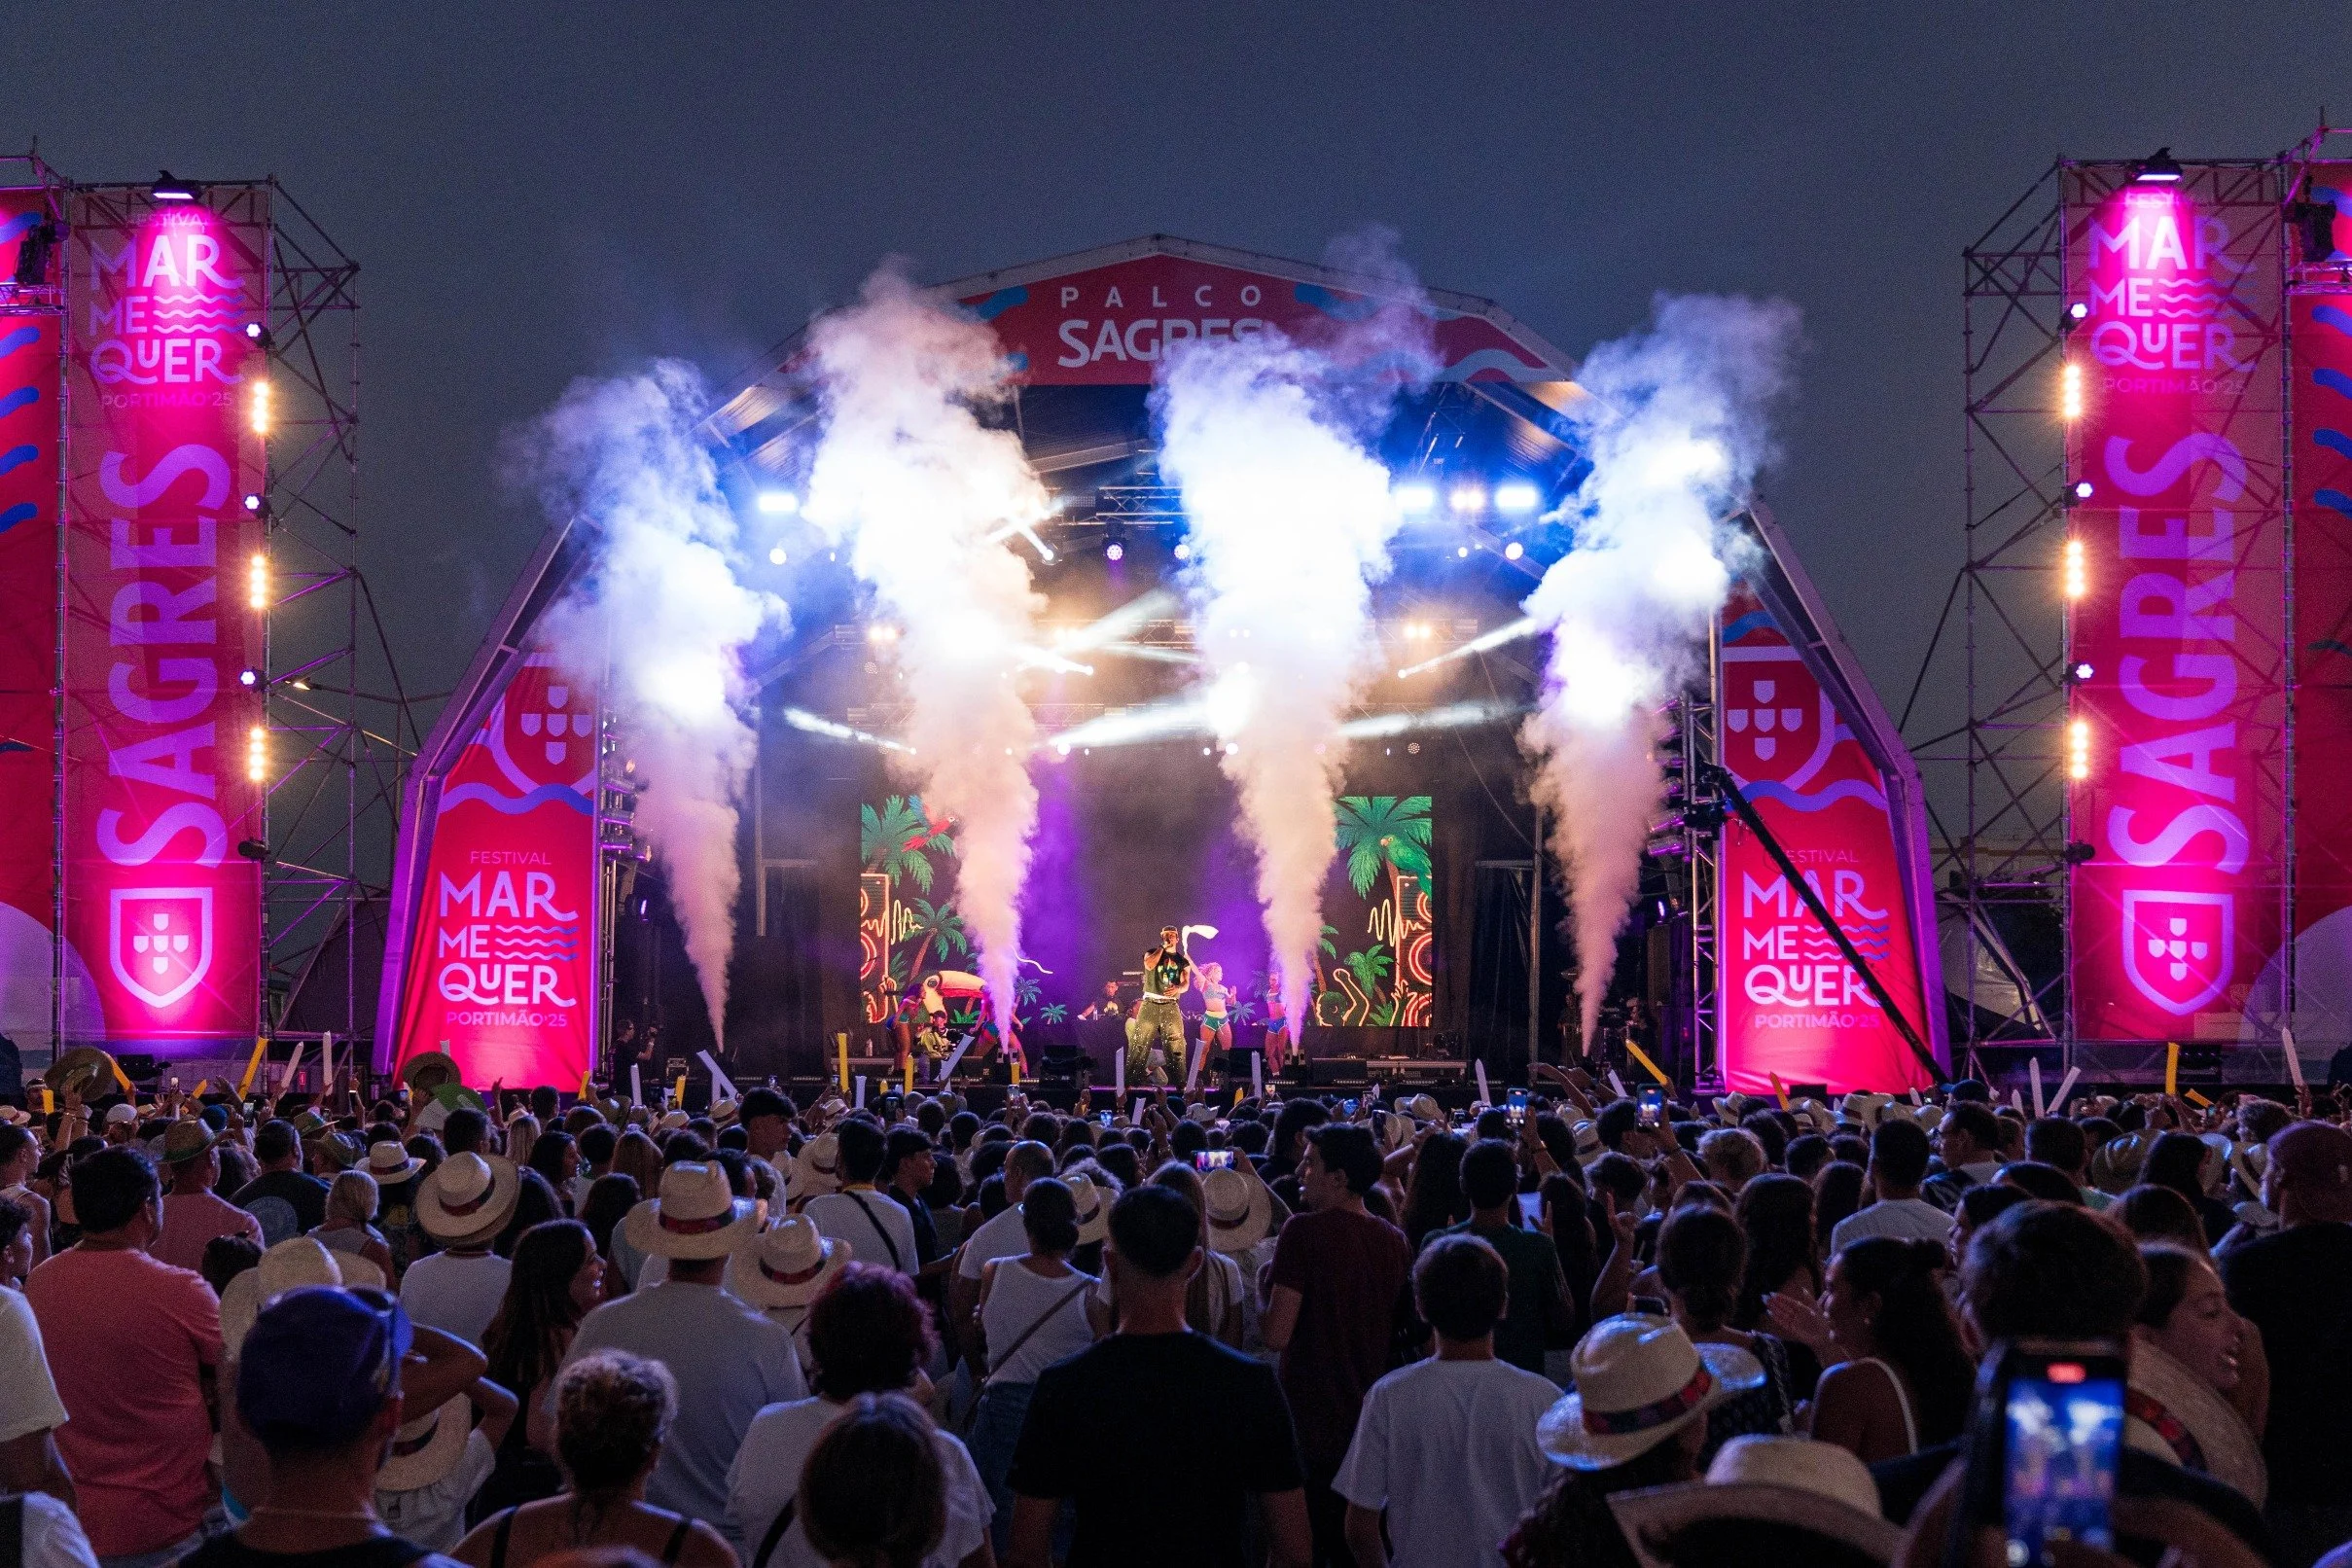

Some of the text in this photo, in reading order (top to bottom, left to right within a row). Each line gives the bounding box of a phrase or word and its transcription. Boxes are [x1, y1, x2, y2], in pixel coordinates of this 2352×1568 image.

[90, 234, 244, 290] MAR
[2088, 214, 2258, 273] MAR
[89, 296, 148, 337] ME
[1060, 285, 1262, 308] PALCO
[2089, 277, 2154, 317] ME
[89, 338, 244, 385] QUER
[2090, 320, 2258, 373] QUER
[97, 444, 232, 869] SAGRES
[2103, 432, 2249, 874] SAGRES
[470, 850, 552, 865] FESTIVAL
[1784, 849, 1860, 864] ESTIVAL
[440, 871, 579, 922] MAR
[439, 924, 490, 959] ME
[1742, 925, 1800, 960] ME
[439, 962, 577, 1008] QUER
[446, 1010, 568, 1027] PORTIMÃO'25
